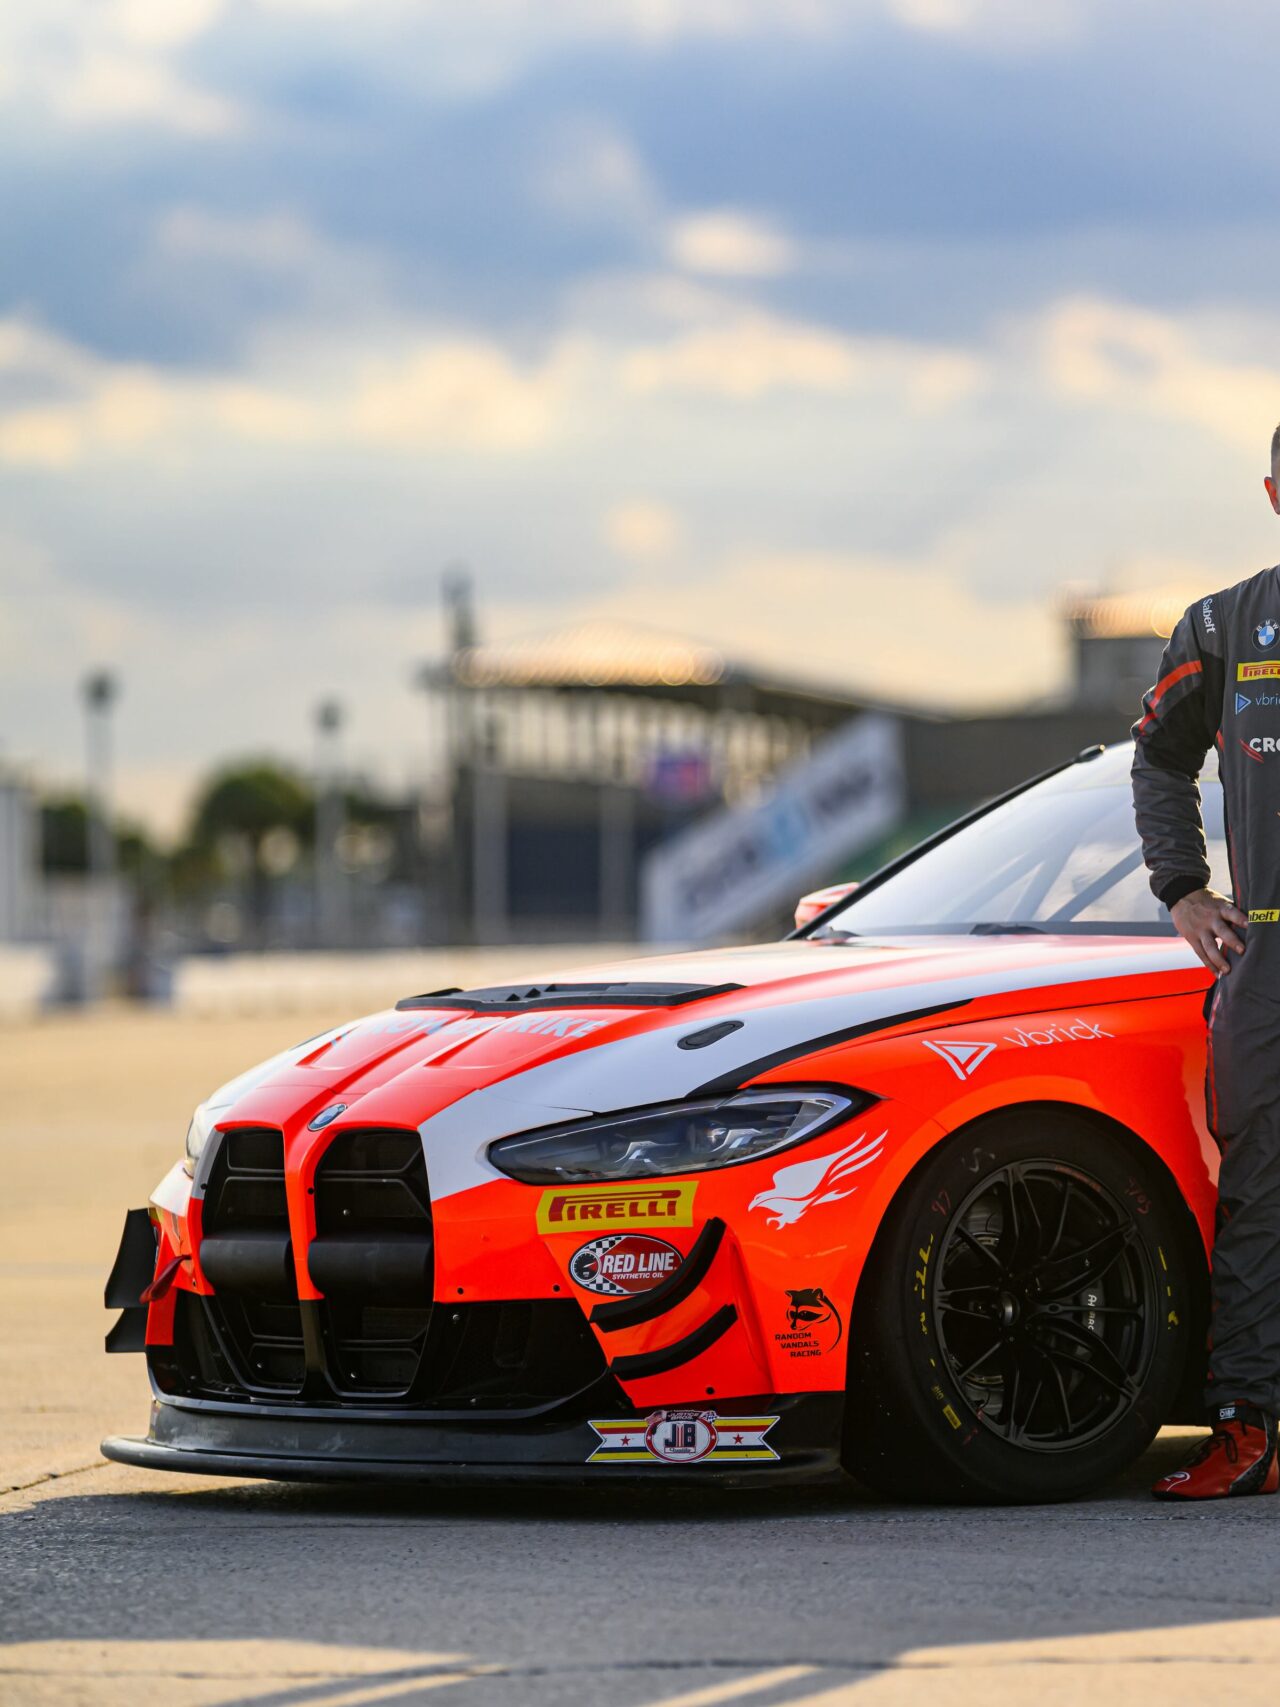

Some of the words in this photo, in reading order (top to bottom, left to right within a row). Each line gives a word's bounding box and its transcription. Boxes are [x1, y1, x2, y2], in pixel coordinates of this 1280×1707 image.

[1203, 598, 1216, 634] Sabelt
[1248, 911, 1274, 921] belt
[1003, 1018, 1115, 1048] vbrick
[548, 1189, 682, 1222] PIRELLI
[602, 1254, 636, 1274] RED
[775, 1332, 811, 1340] RANDOM
[781, 1340, 819, 1349] VANDALS
